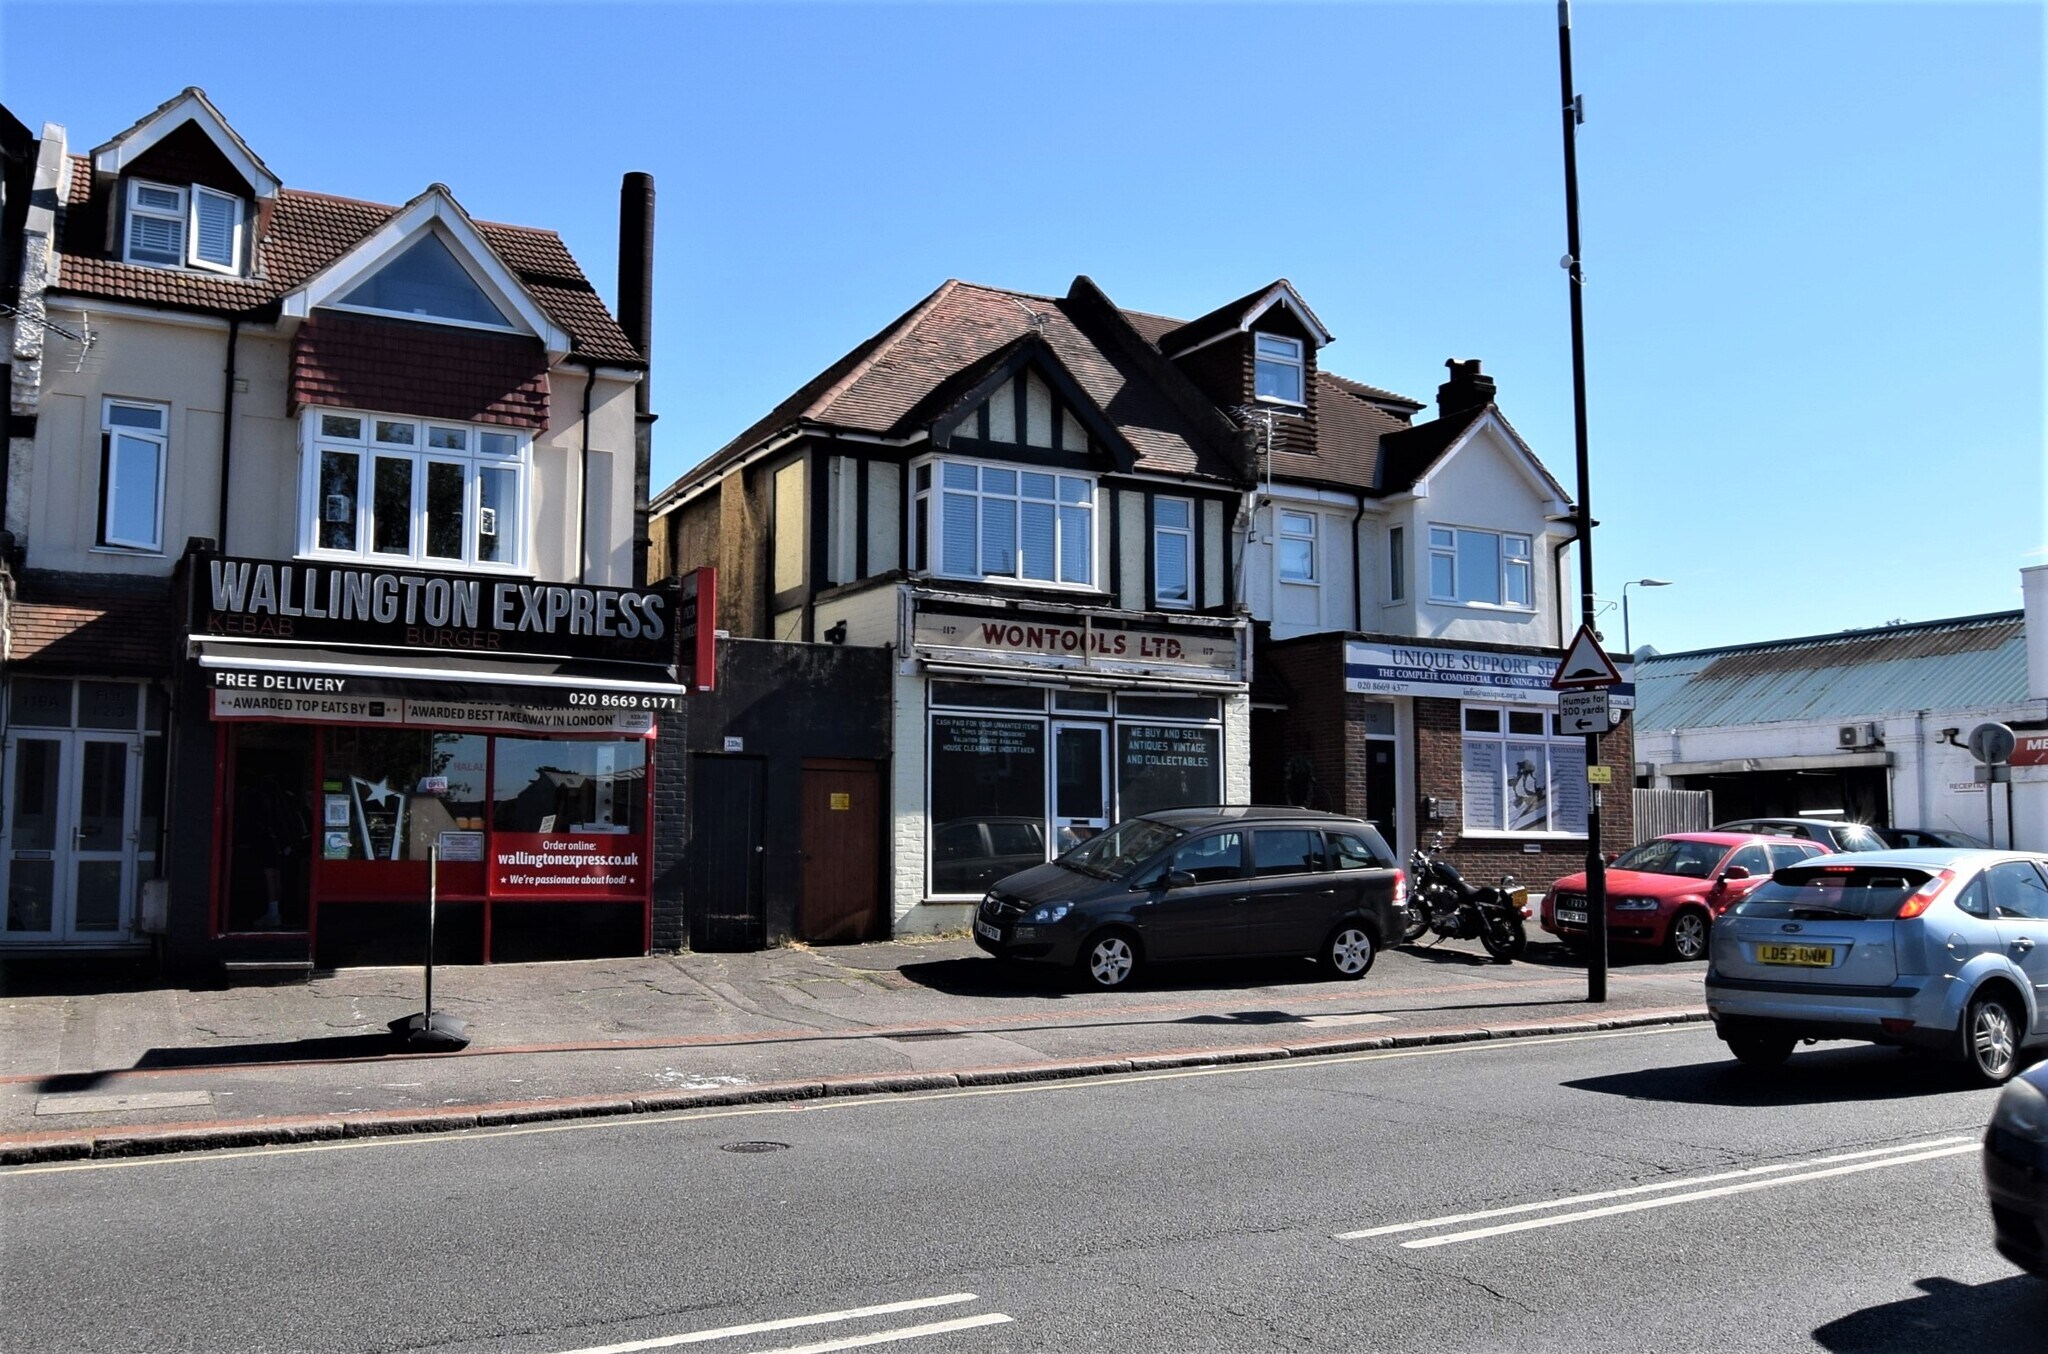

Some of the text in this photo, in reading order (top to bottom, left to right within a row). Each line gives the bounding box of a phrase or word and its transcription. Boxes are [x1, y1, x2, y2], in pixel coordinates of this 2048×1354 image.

[210, 560, 666, 641] WALLINGTON EXPRESS
[207, 613, 294, 636] KEBAB
[406, 627, 500, 649] BURGER
[943, 623, 1215, 659] 117 WONTOOLS LTD. 117
[1391, 649, 1455, 672] UNIQUE
[1462, 654, 1532, 674] SUPPORT
[215, 672, 346, 692] FREE DELIVERY
[1378, 668, 1395, 677] THE
[1396, 669, 1439, 680] COMPLETE
[1440, 673, 1492, 684] COMMERCIAL
[1494, 677, 1533, 687] CLEANING
[1357, 681, 1409, 692] 020 8669 4377
[233, 697, 293, 711] AWARDED
[297, 700, 319, 712] TOP
[321, 702, 349, 713] EATS
[351, 704, 366, 715] BY
[569, 692, 597, 706] 020
[601, 694, 637, 709] 8669
[641, 697, 677, 710] 6171
[1563, 694, 1606, 708] Humps for
[467, 709, 494, 721] BEST
[496, 710, 551, 726] TAKEAWAY
[553, 716, 565, 726] IN
[1562, 706, 1605, 717] 300 yards
[1131, 727, 1203, 740] WE BUY AND SELL
[1128, 741, 1206, 753] ANTIQUES VINTAGE
[454, 762, 485, 772] HALAL
[1126, 754, 1209, 767] AND COLLECTABLES
[543, 841, 597, 850] Order online:
[498, 852, 638, 868] wallingtonexpress.co.uk
[510, 875, 627, 886] We're passionate about food!
